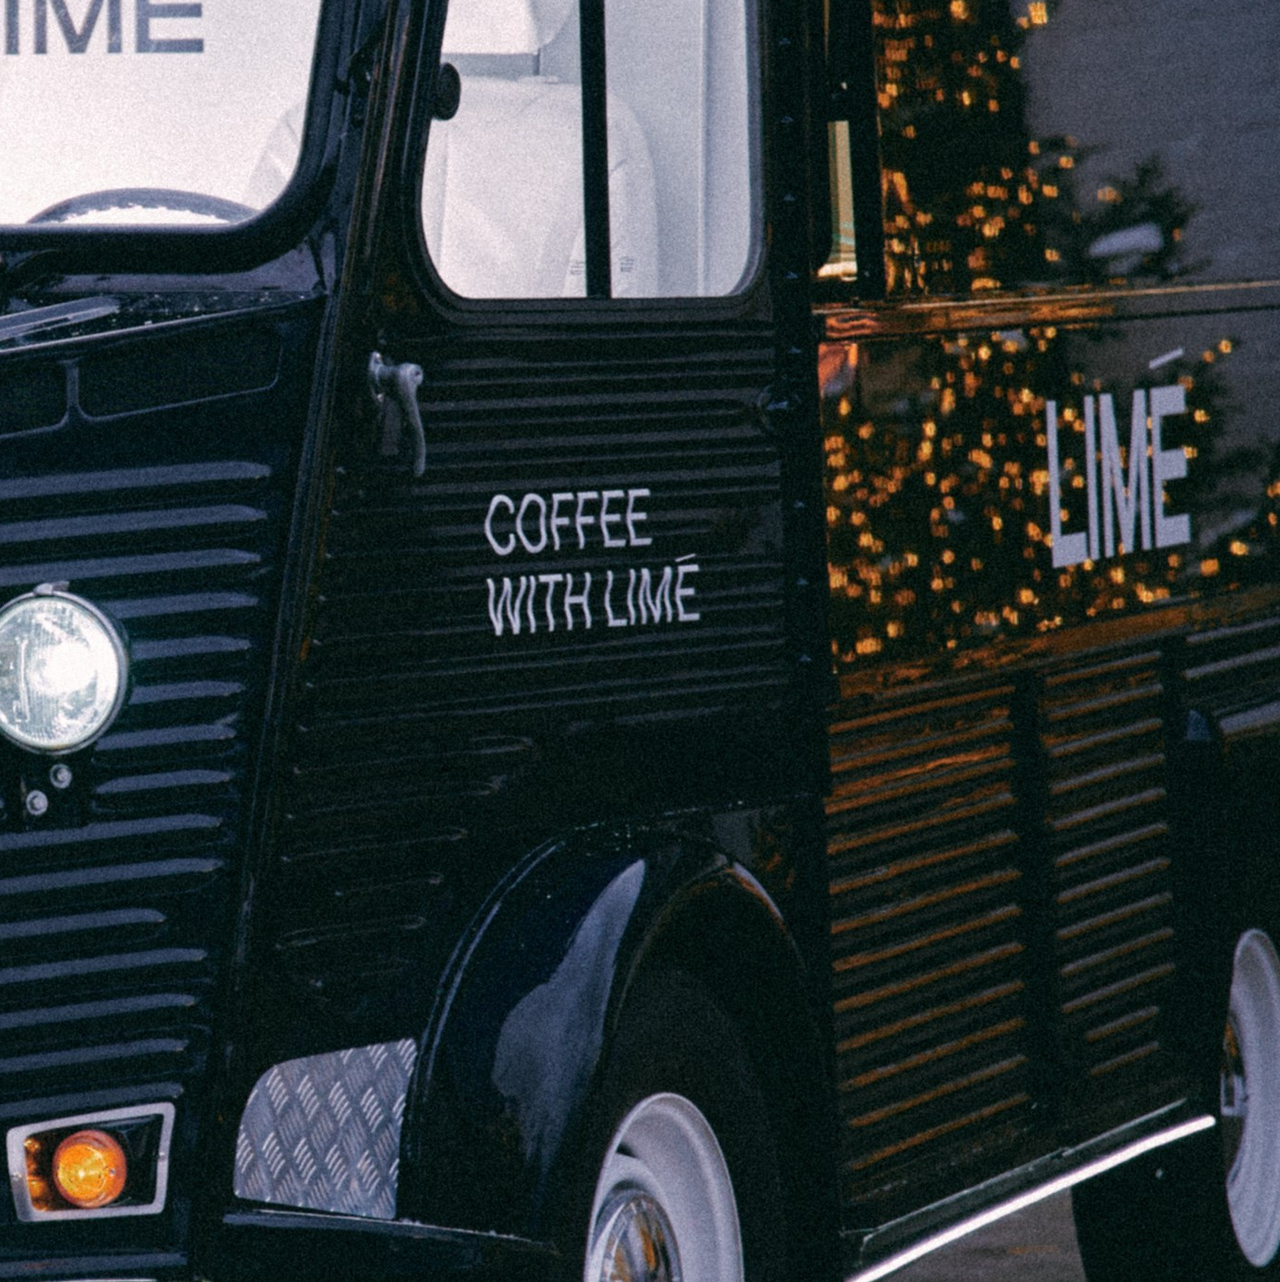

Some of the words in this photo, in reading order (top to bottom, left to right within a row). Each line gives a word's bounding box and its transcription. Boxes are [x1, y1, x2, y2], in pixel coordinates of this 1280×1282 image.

[1046, 347, 1191, 569] LIMÉ
[485, 488, 653, 556] COFFEE
[486, 572, 592, 636] WITH
[604, 553, 701, 627] LIMÉ
